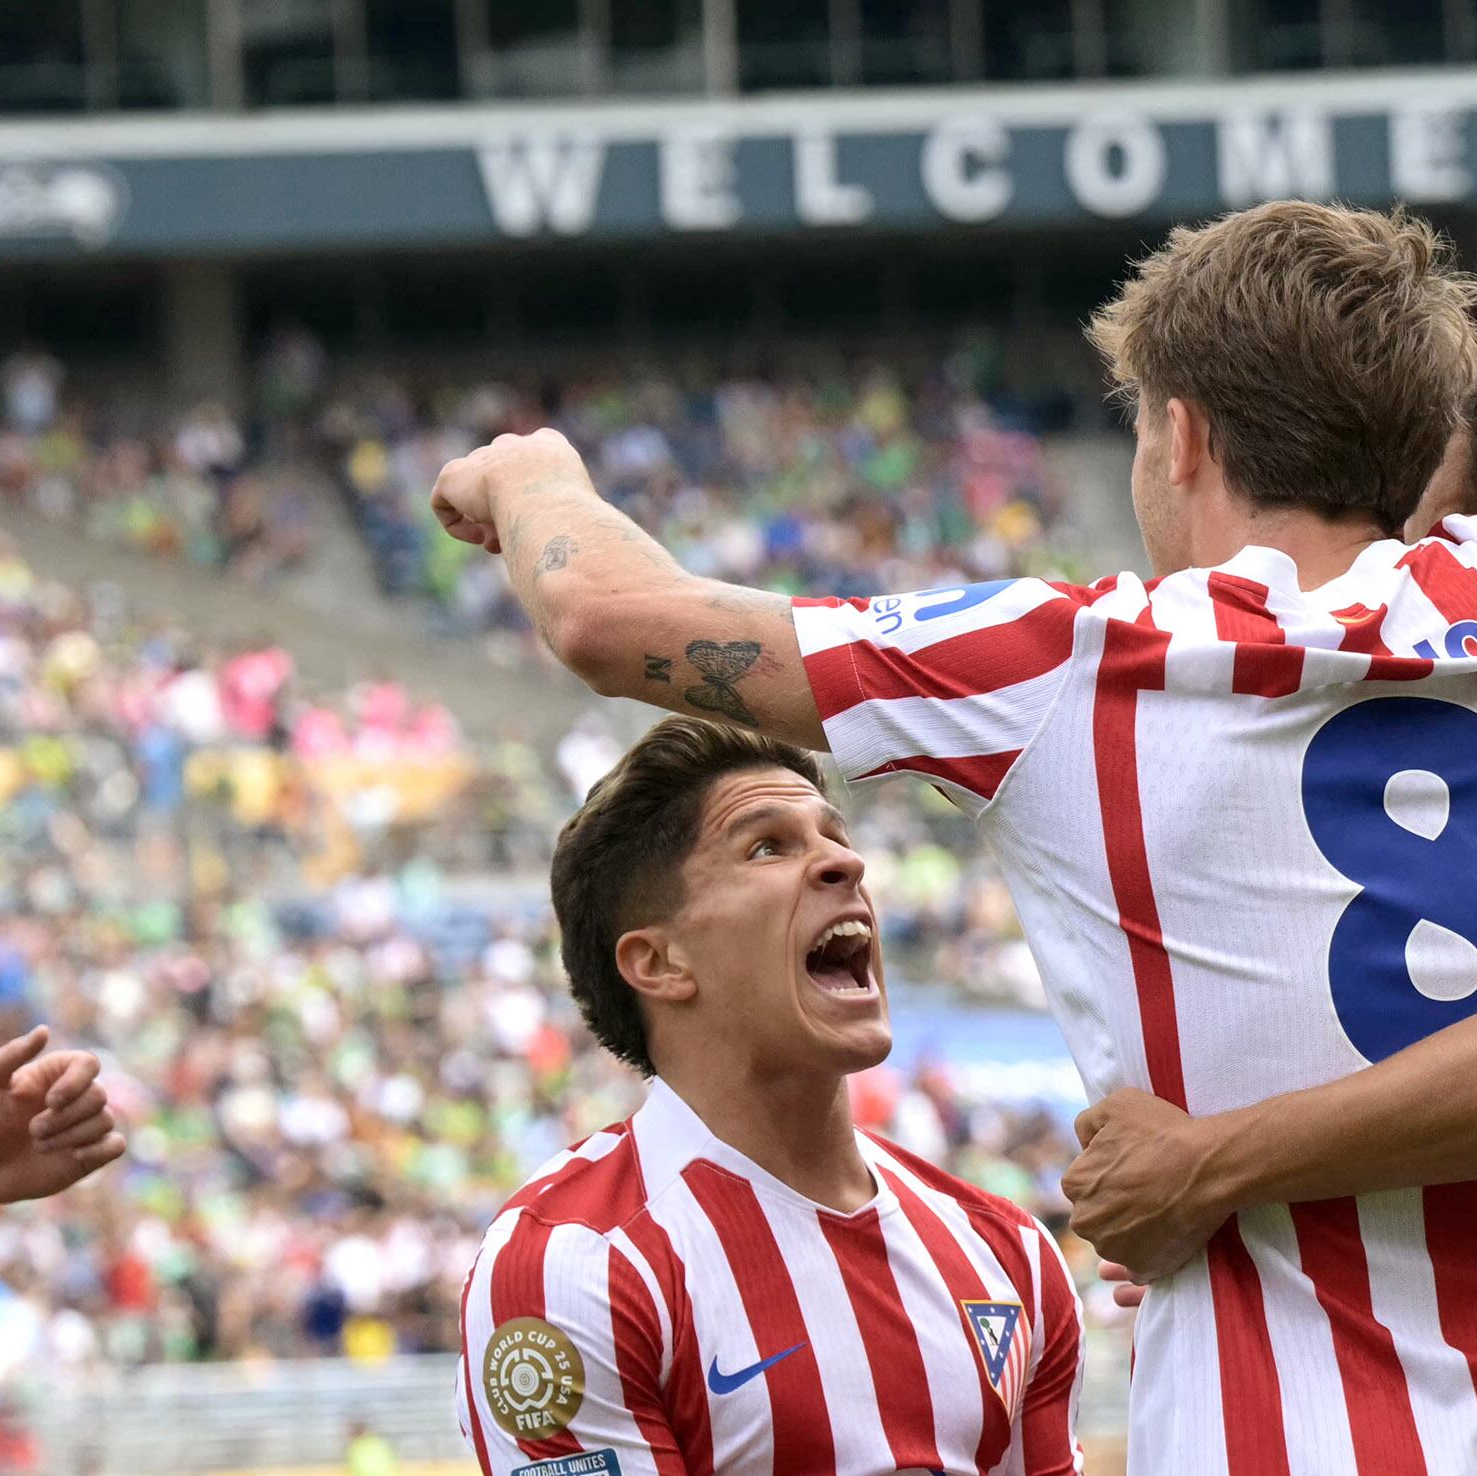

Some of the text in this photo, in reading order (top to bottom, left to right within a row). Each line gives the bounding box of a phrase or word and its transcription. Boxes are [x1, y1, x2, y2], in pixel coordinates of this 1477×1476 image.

[477, 102, 1474, 238] WELCOME
[489, 1330, 573, 1415] CLUB WORLD CUP 25 USA
[515, 1410, 556, 1431] FIFA
[568, 1454, 606, 1473] UNITES
